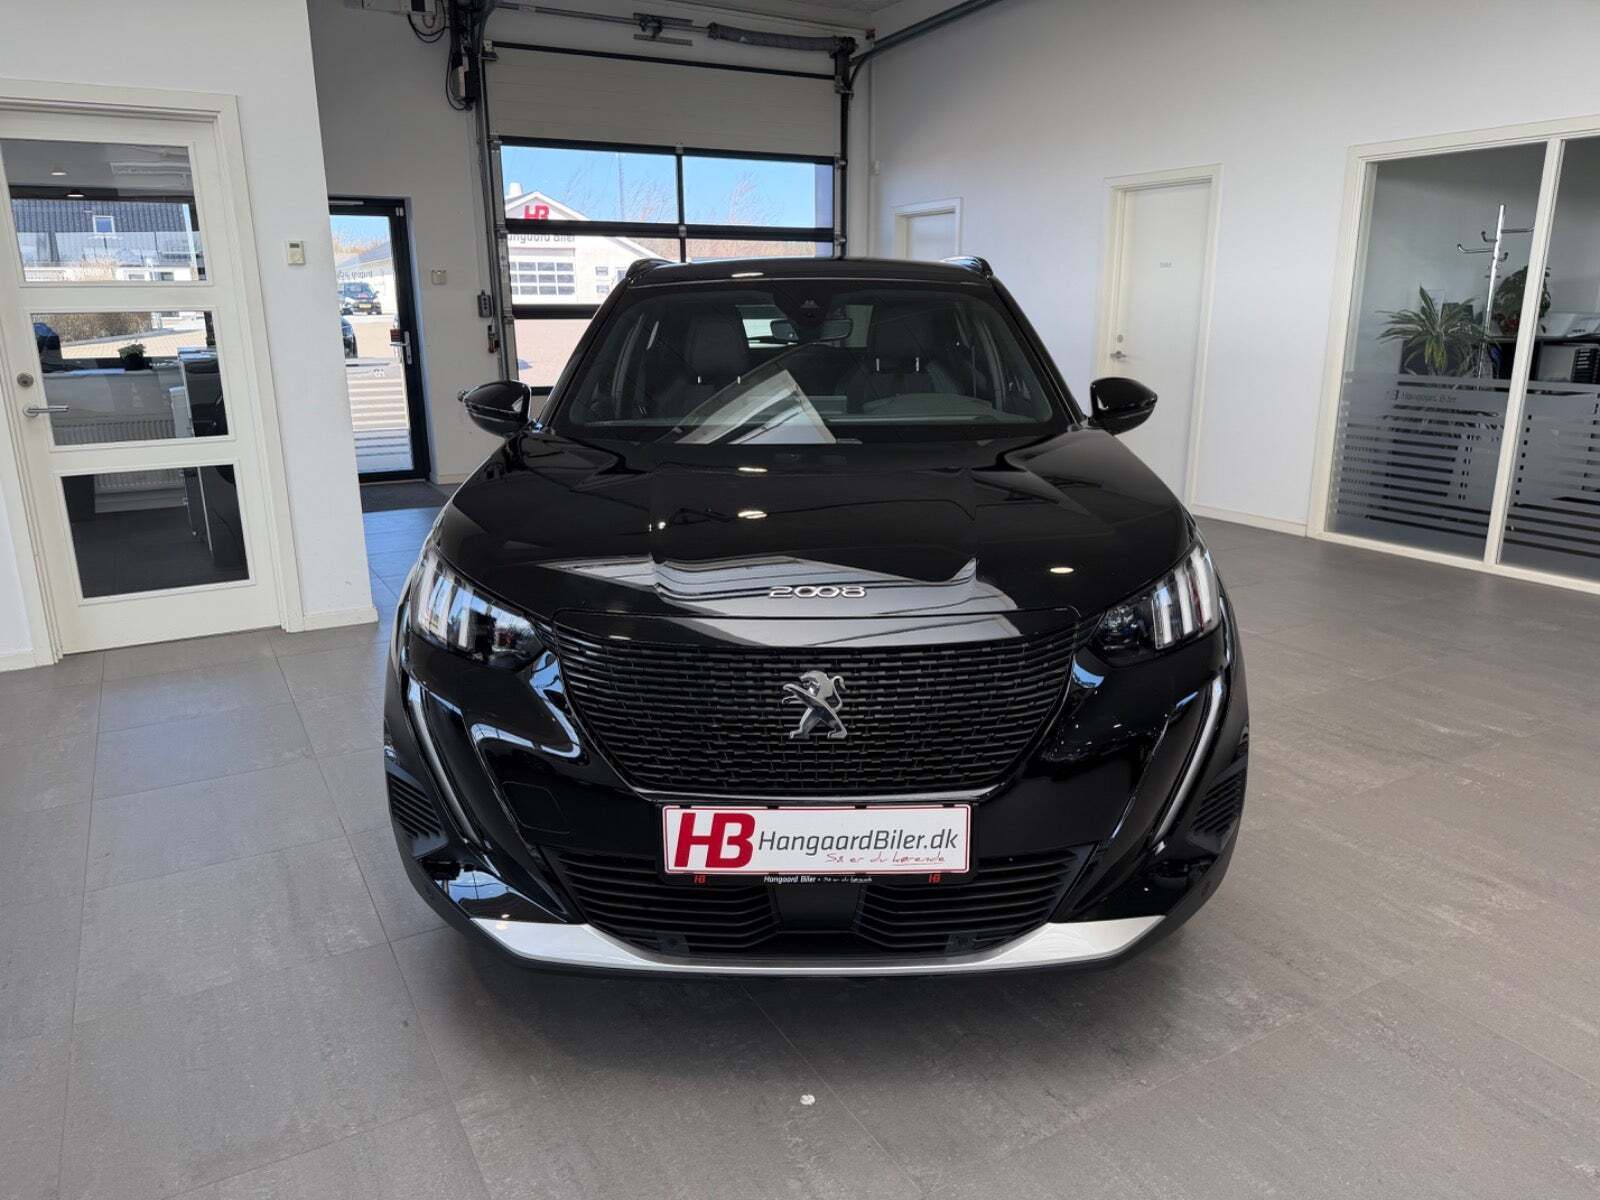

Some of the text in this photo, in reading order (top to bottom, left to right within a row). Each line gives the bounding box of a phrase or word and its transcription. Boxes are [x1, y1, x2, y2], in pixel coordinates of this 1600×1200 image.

[769, 585, 866, 598] 2008
[674, 812, 756, 868] HB
[758, 828, 958, 856] HangaardBiler.dk
[764, 875, 799, 885] Hangaard
[800, 875, 817, 883] Biler
